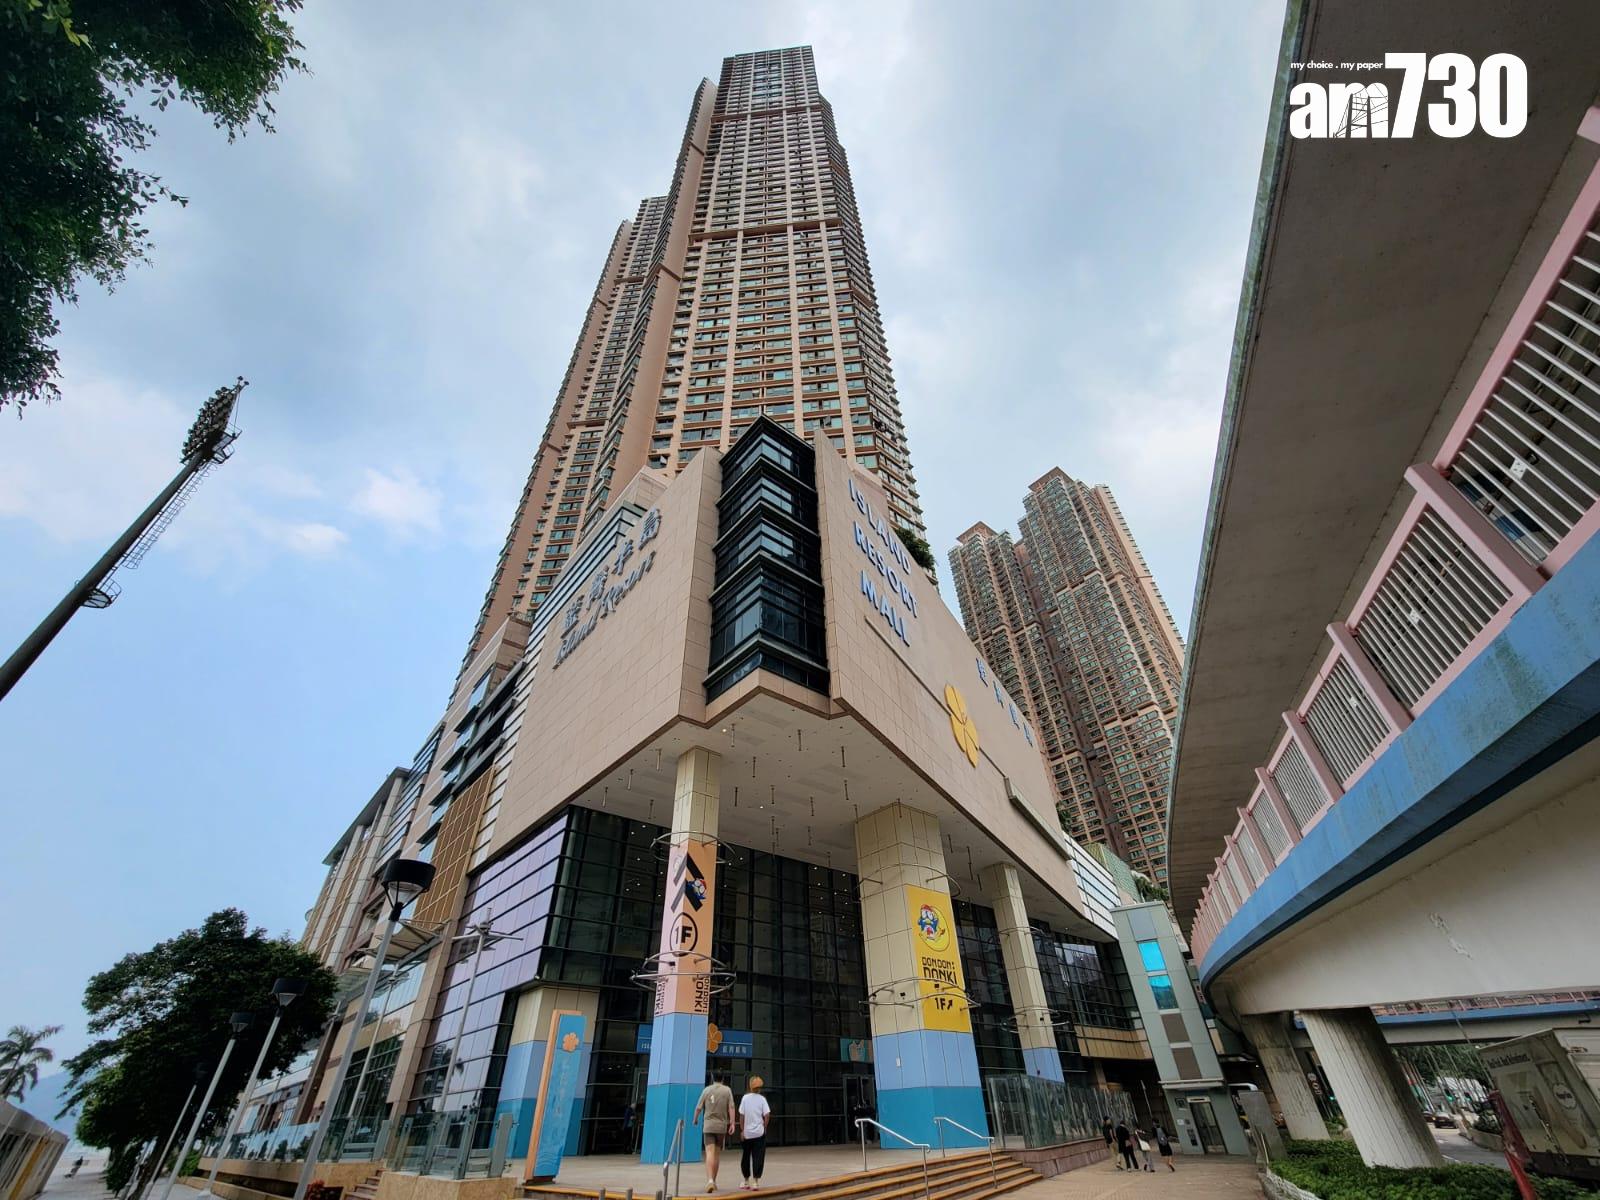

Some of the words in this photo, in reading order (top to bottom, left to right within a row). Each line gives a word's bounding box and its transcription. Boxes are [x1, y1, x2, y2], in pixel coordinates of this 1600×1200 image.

[849, 478, 912, 576] ISLAND
[854, 520, 918, 619] RESORT
[552, 602, 602, 670] Island
[600, 550, 657, 619] Resort
[861, 569, 911, 647] MALL
[675, 925, 693, 945] 1F
[934, 997, 946, 1010] 1F
